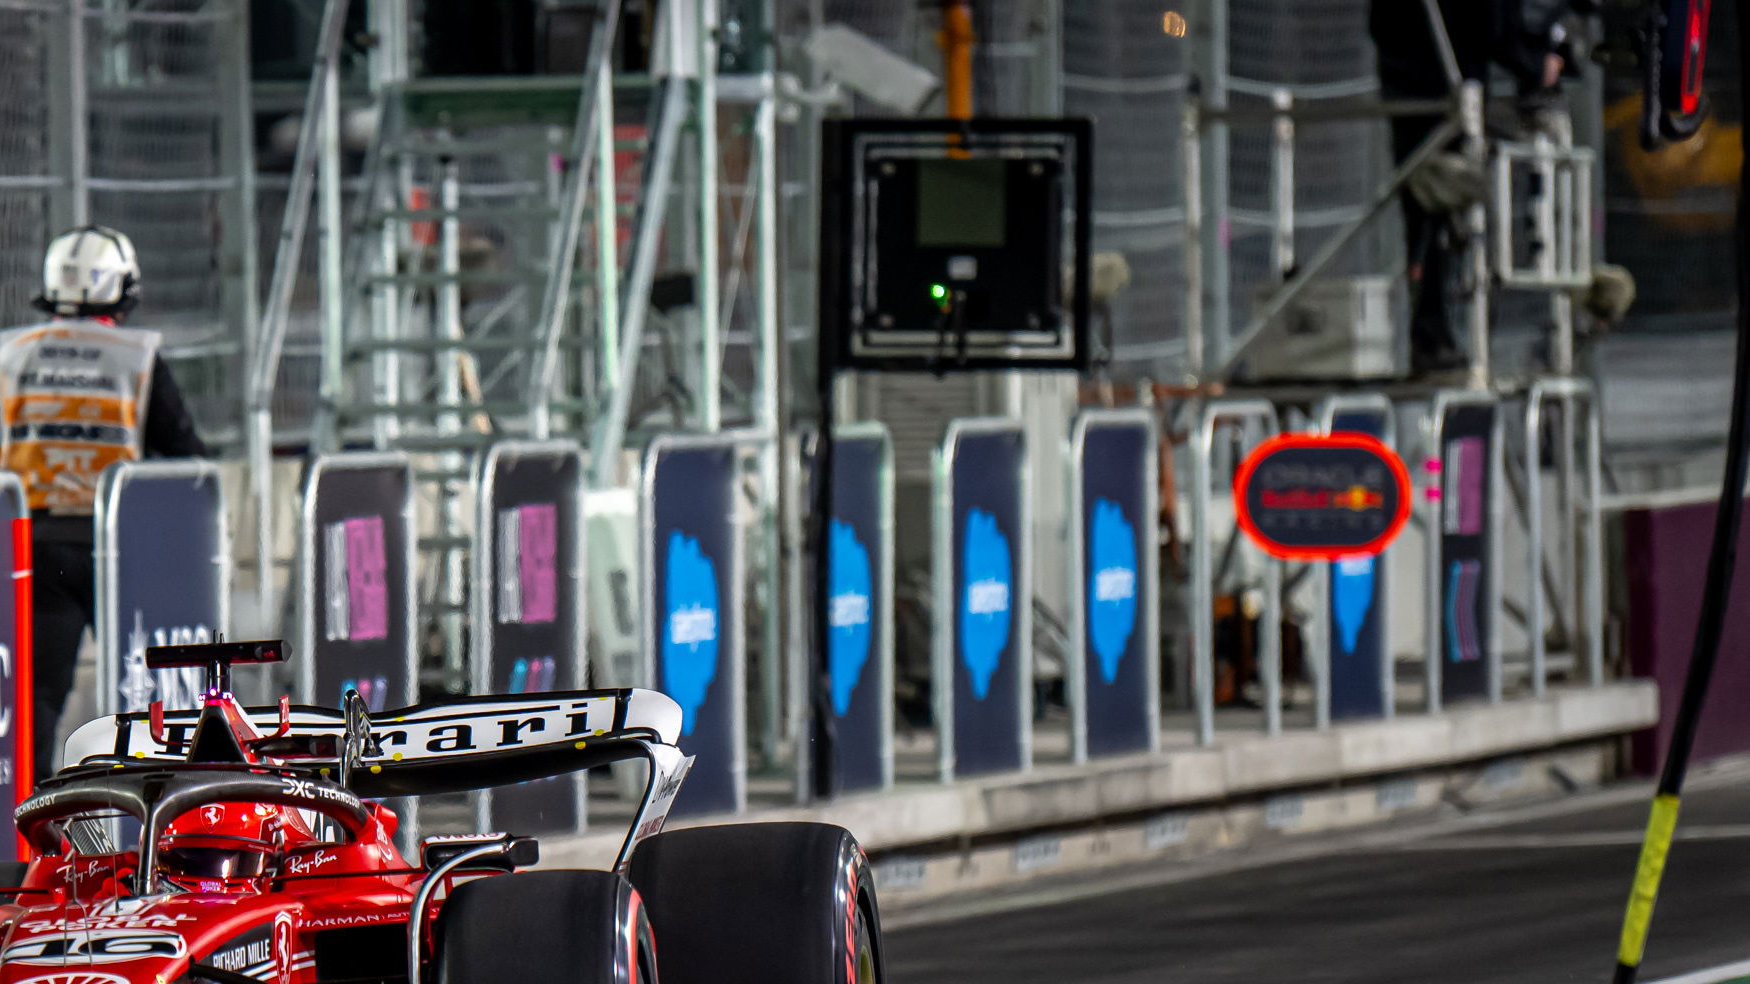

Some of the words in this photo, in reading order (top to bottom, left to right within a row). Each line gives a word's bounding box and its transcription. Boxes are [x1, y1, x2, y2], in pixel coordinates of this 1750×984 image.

[282, 778, 316, 799] DXC
[56, 860, 110, 884] Ray-Ban
[285, 850, 338, 874] Ray-Ban
[298, 914, 380, 927] HARMAN
[2, 932, 183, 962] 16
[247, 938, 271, 966] MILLE
